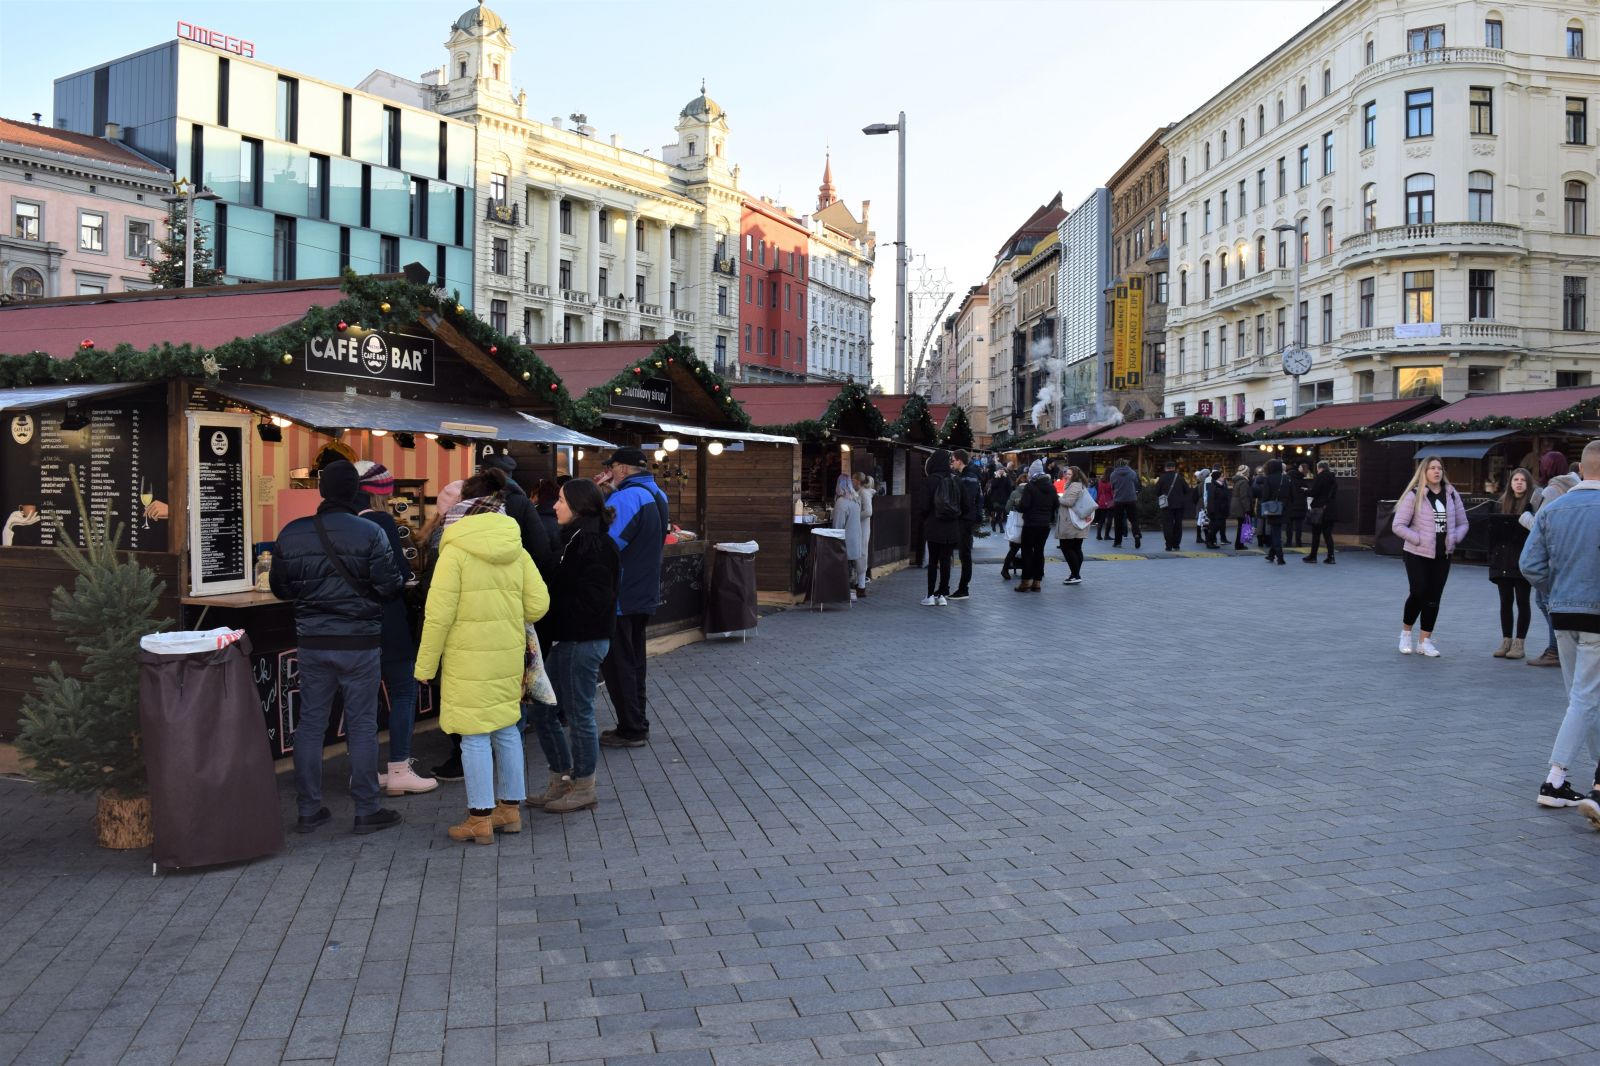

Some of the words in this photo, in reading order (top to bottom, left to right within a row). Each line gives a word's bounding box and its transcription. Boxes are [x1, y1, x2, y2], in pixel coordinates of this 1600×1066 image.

[177, 20, 256, 58] OMEGA
[310, 335, 358, 364] CAFÉ
[391, 347, 422, 371] BAR
